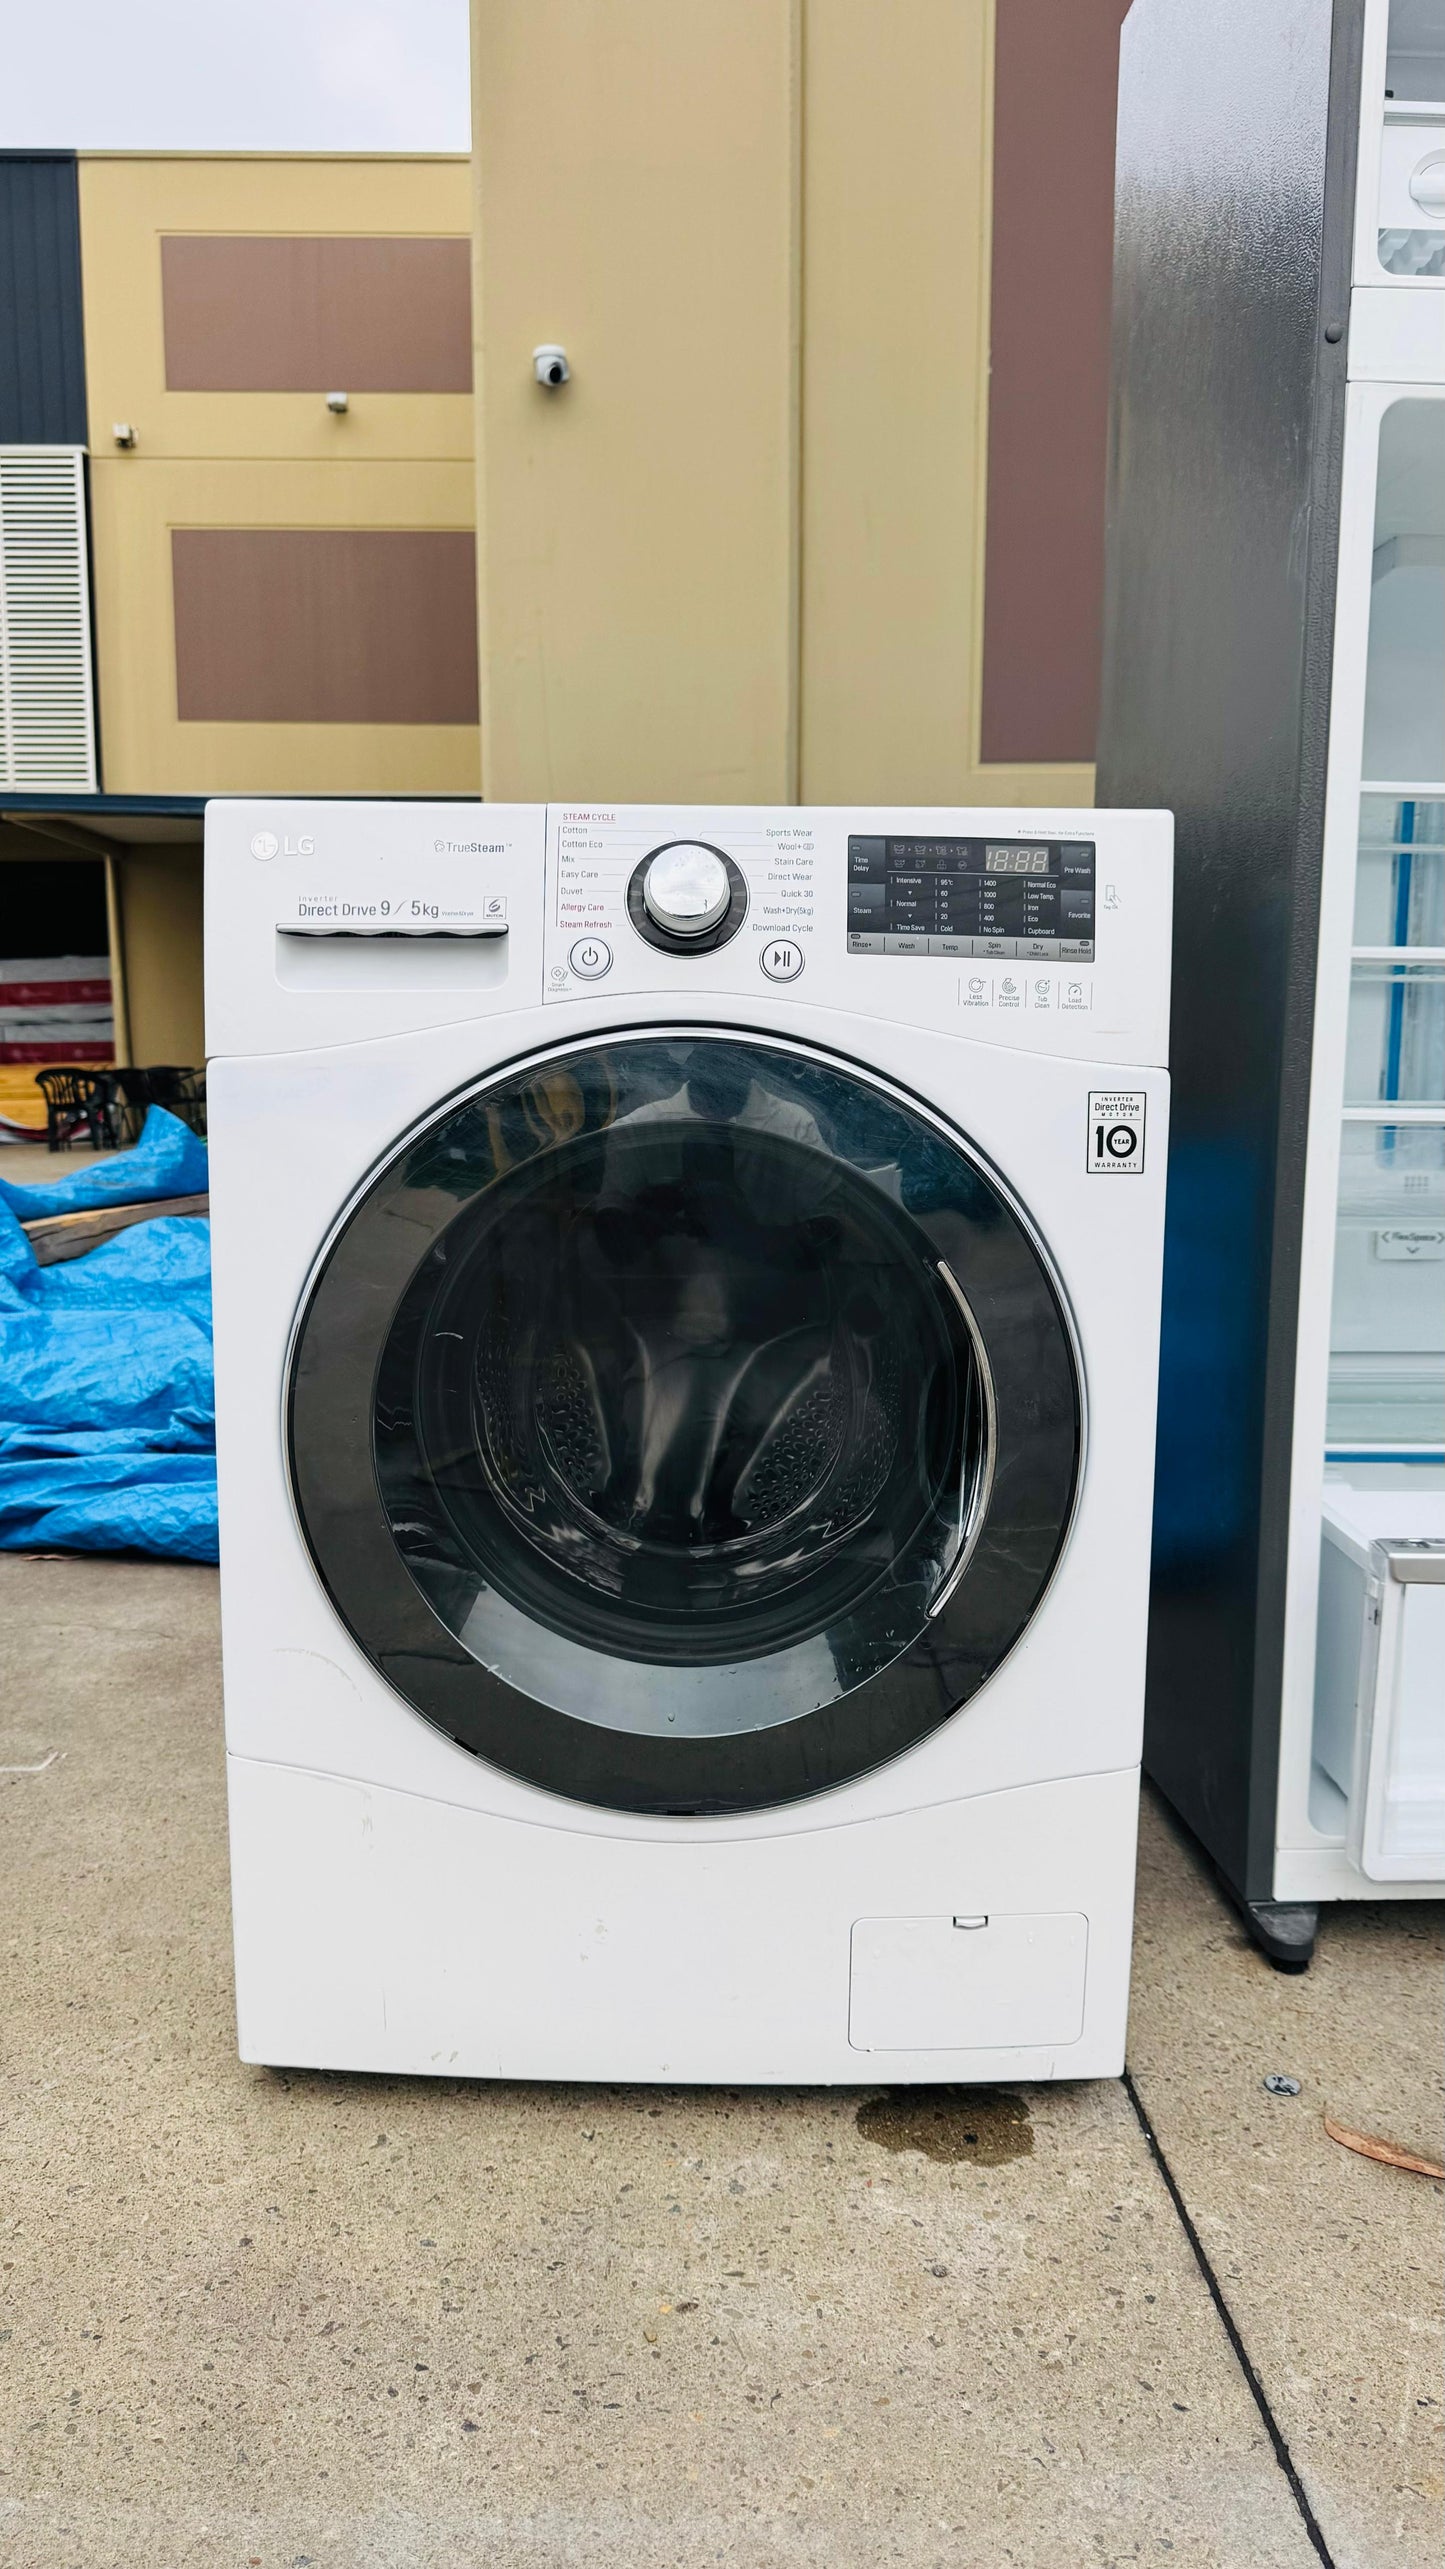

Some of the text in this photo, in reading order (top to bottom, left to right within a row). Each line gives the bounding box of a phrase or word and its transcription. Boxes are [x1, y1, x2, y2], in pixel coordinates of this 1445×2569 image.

[562, 826, 588, 834] Cotton
[766, 829, 791, 837] Sports
[283, 835, 316, 856] LG
[562, 840, 588, 848] Cotton
[853, 865, 869, 873] Delay
[561, 870, 579, 879] Easy
[767, 873, 813, 881] Direct Wear
[1046, 881, 1057, 889] Eco
[560, 887, 583, 895] Duvet
[781, 890, 814, 898] Quick 30
[298, 903, 339, 917] Direct
[341, 903, 377, 917] Drive
[380, 900, 391, 916] 9
[411, 900, 439, 919] 5kg
[561, 903, 586, 912] Allergy
[983, 902, 995, 910] 800
[559, 920, 613, 928] Steam Refresh
[752, 923, 814, 933] Download Cycle
[992, 926, 1005, 934] Spin
[1027, 927, 1055, 936] Cupboard
[942, 943, 959, 951] Temp
[1032, 943, 1044, 951] Dry
[1094, 1102, 1140, 1111] Direct Drive
[1096, 1124, 1137, 1158] 10
